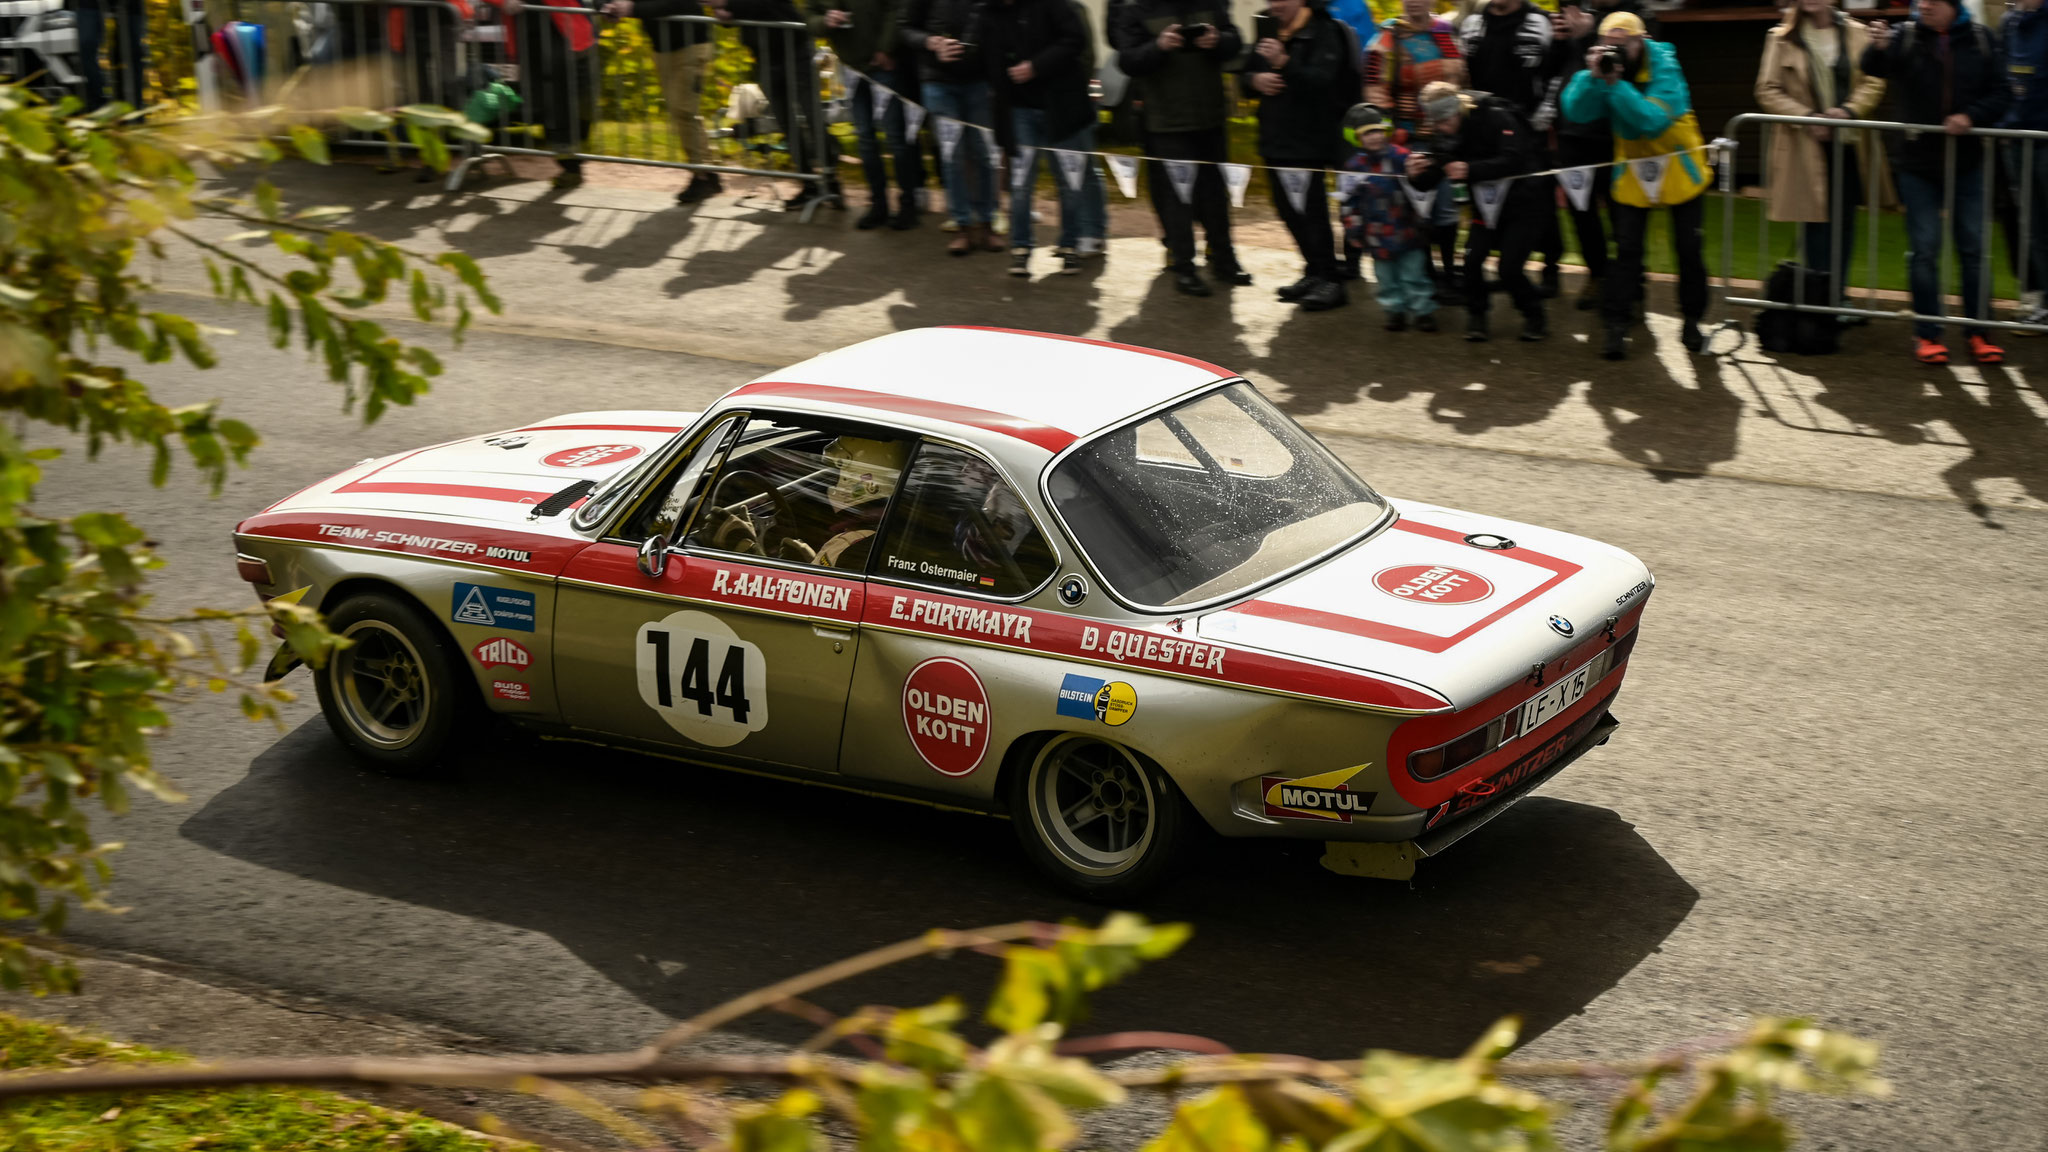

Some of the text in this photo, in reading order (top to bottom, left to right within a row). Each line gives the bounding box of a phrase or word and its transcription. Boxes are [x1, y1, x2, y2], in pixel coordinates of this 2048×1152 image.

[888, 555, 978, 583] Franz Ostermaier
[1392, 566, 1454, 596] OLDEN
[712, 569, 852, 611] R.AALTONEN
[1418, 574, 1470, 600] KOTT
[1615, 581, 1648, 606] SCHNITZER
[478, 638, 529, 666] TRICO
[494, 681, 522, 690] auto
[646, 629, 751, 725] 144
[1571, 670, 1586, 701] 15
[907, 688, 984, 724] OLDEN
[1059, 689, 1094, 704] BILSTEIN
[1111, 698, 1133, 706] GASDRUCK
[916, 714, 975, 748] KOTT
[1282, 788, 1368, 812] MOTUL
